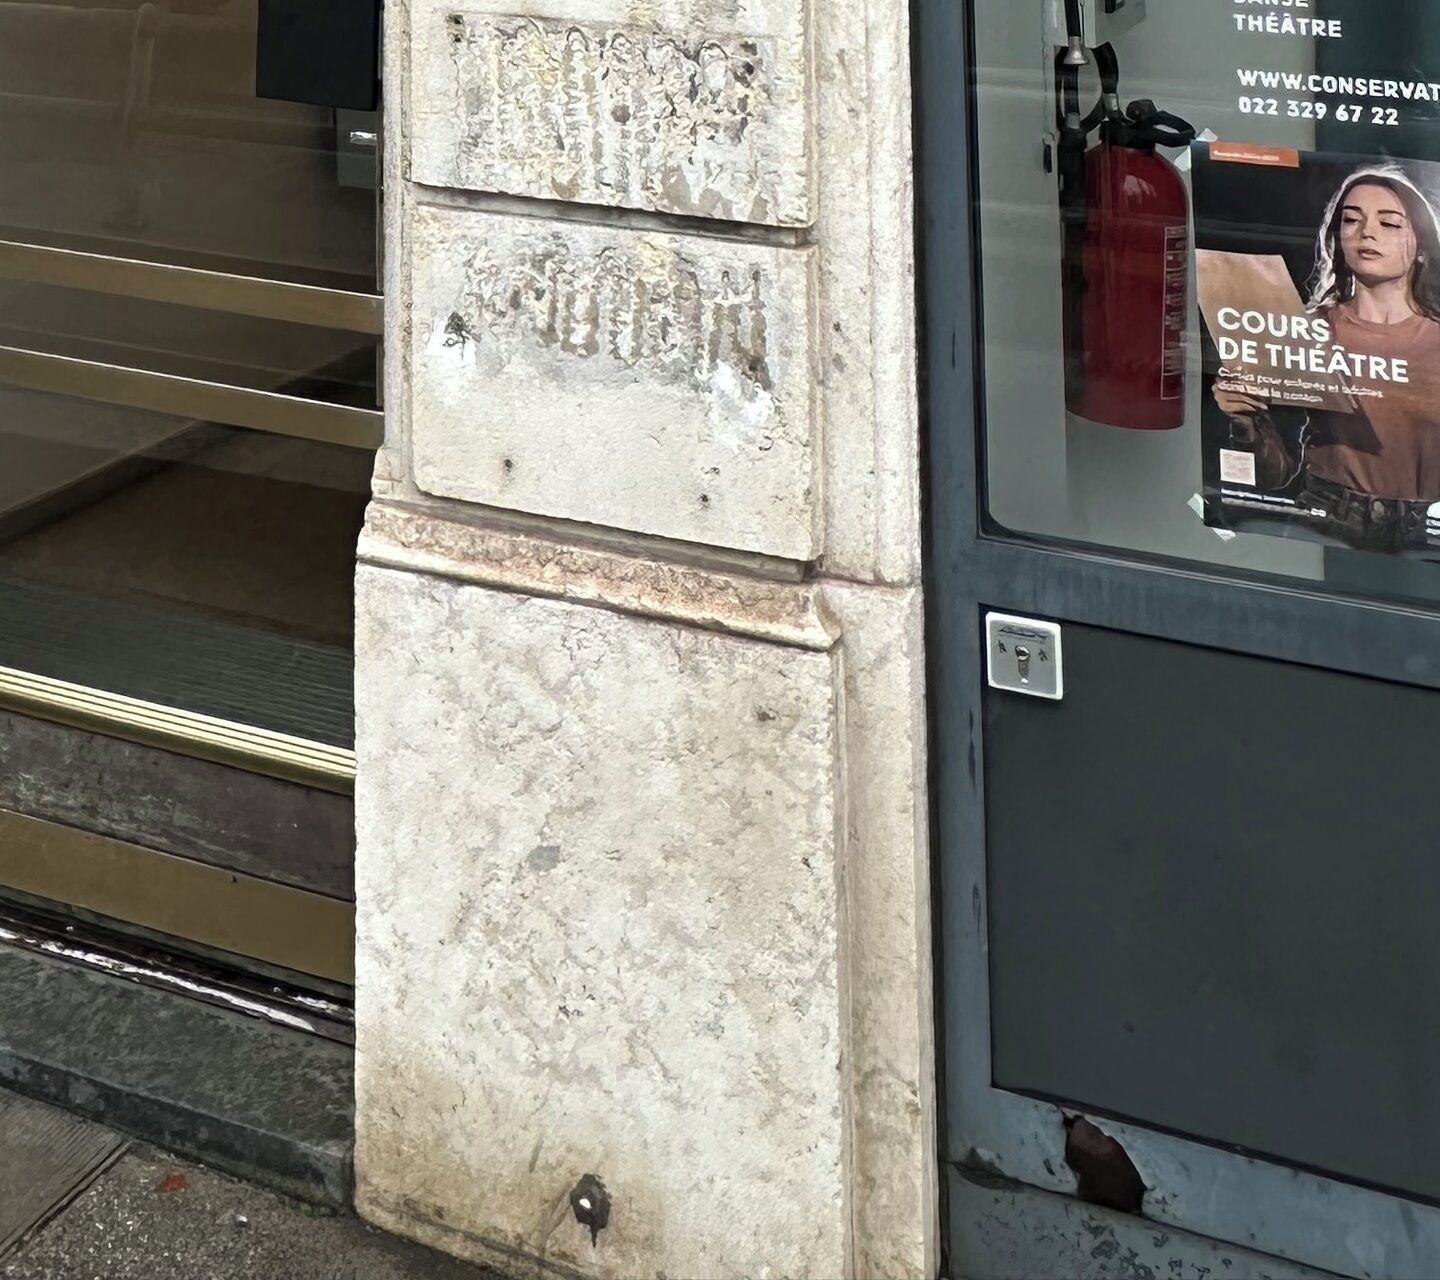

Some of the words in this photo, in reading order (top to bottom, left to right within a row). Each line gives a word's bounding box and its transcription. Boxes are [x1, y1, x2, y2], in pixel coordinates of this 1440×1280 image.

[1233, 11, 1343, 38] THÉÂTRE
[1238, 98, 1279, 117] 022
[1287, 100, 1327, 121] 329
[1335, 104, 1362, 123] 67
[1370, 107, 1399, 127] 22
[1217, 306, 1330, 343] COURS
[1218, 336, 1258, 365] DE
[1265, 342, 1409, 383] THÉÂTRE
